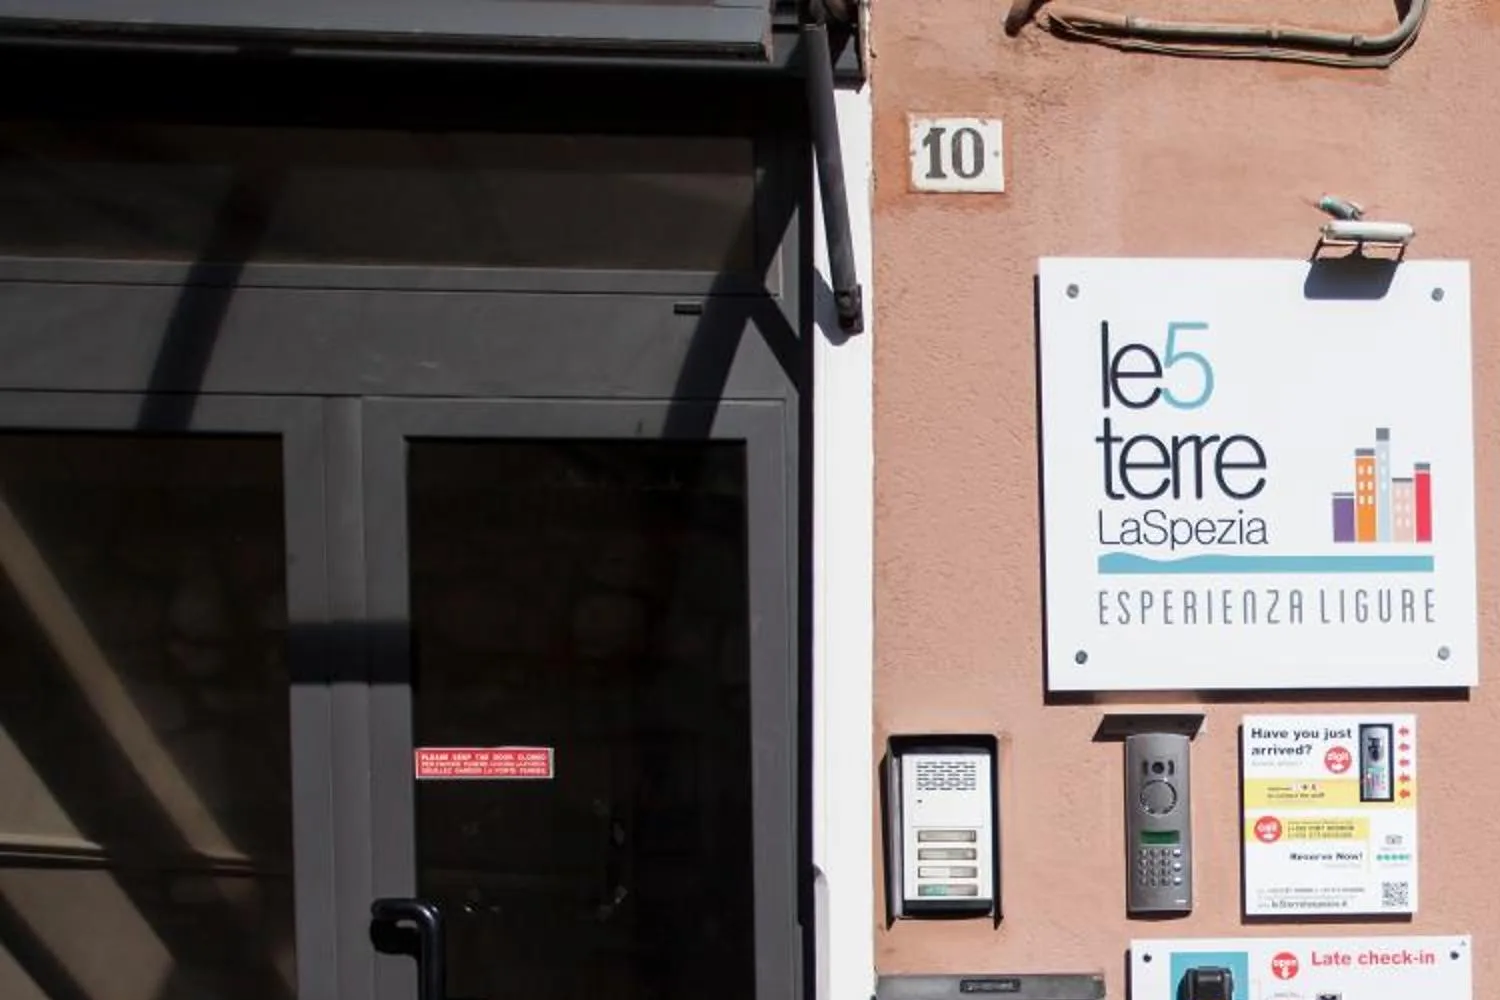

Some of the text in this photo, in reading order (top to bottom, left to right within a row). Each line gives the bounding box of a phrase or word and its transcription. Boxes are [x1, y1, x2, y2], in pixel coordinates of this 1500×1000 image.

[922, 127, 985, 179] 10
[1100, 320, 1214, 410] le5
[1095, 417, 1267, 500] terre
[1098, 508, 1269, 550] LaSpezia
[1098, 587, 1436, 625] ESPERIENZA LIGURE
[1250, 727, 1353, 741] Have you just
[1250, 744, 1313, 757] arrived?
[1311, 949, 1436, 967] Late check-in
